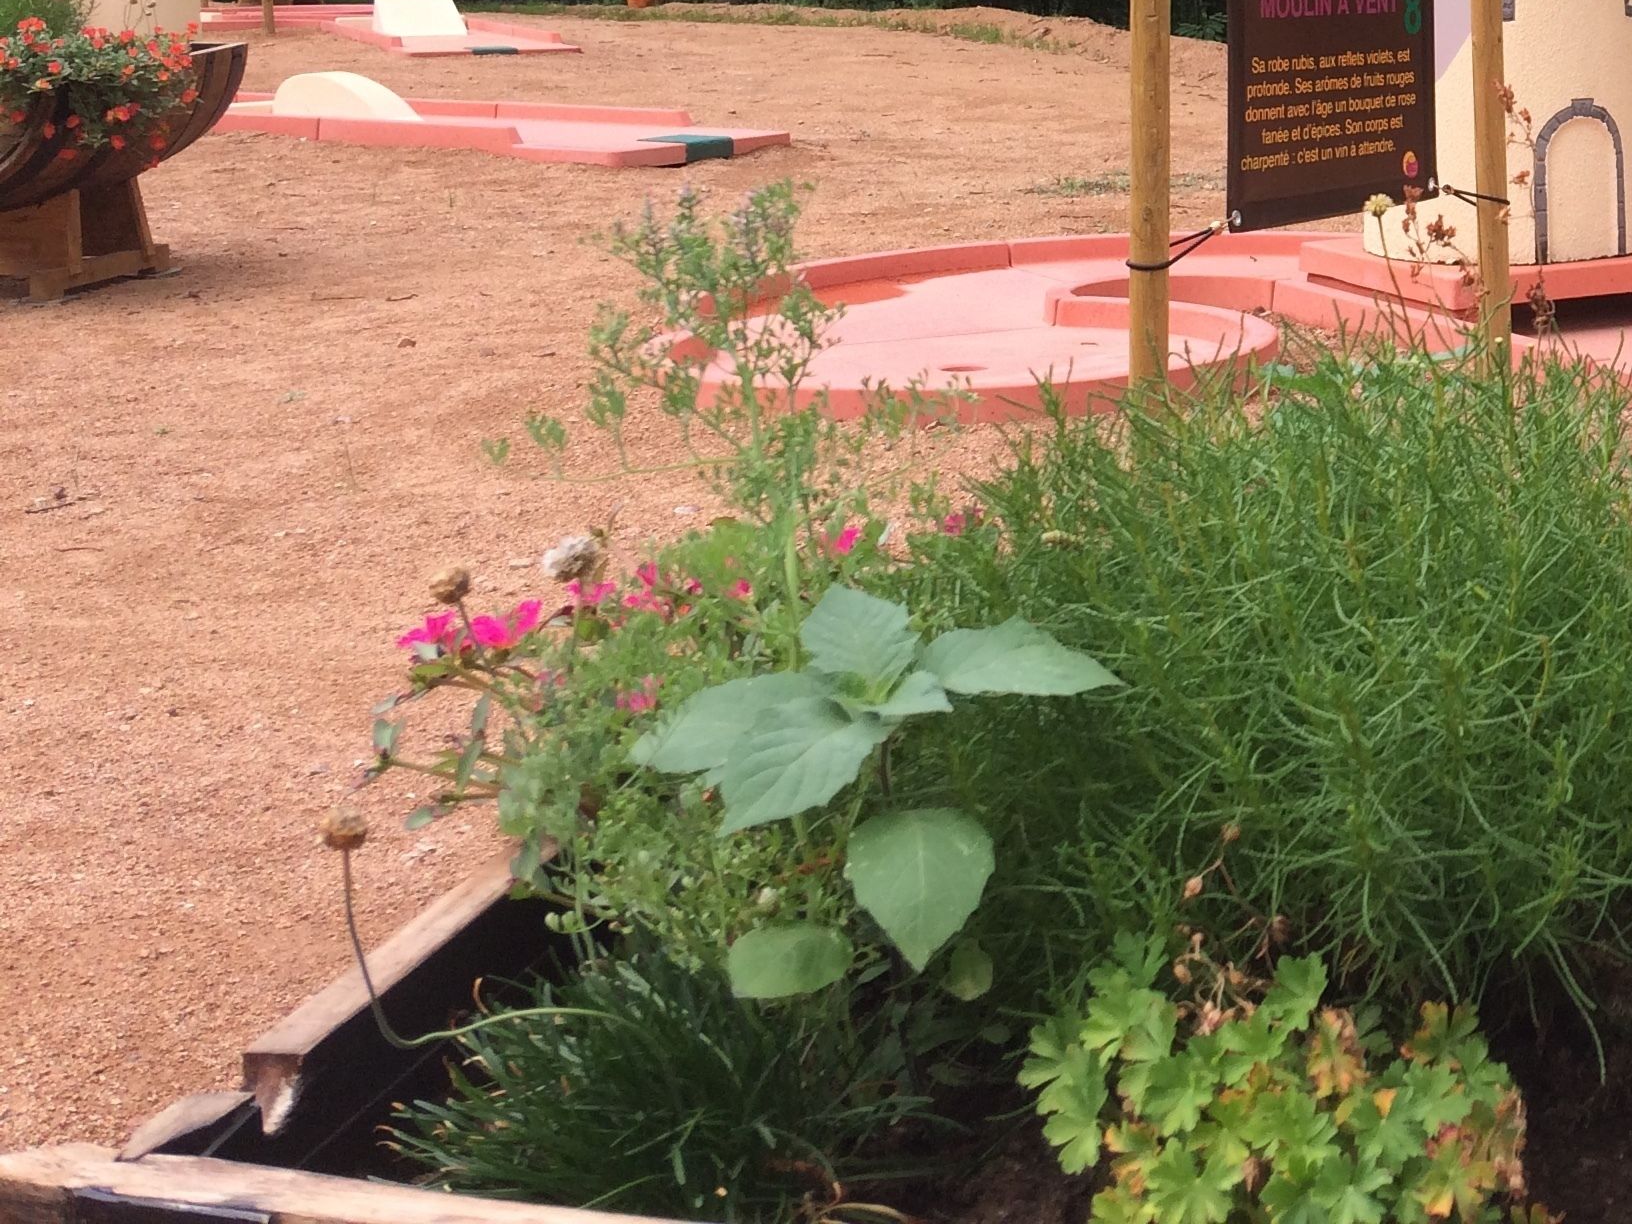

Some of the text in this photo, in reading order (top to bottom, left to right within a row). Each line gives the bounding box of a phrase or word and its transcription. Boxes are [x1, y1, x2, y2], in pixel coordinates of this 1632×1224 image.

[1252, 48, 1410, 73] Sa robe rubis, aux reflets violets, est
[1247, 70, 1415, 102] profonde. Ses arômes de fruits rouges
[1245, 92, 1416, 122] donnent avec l'âge un bouquet de rose
[1262, 114, 1403, 144] fanée et d'épices. Son corps est
[1241, 150, 1289, 172] charpenté
[1297, 148, 1319, 164] c'est
[1321, 148, 1333, 161] un
[1335, 145, 1348, 158] vin
[1351, 144, 1355, 157] à
[1359, 138, 1396, 155] attendre.
